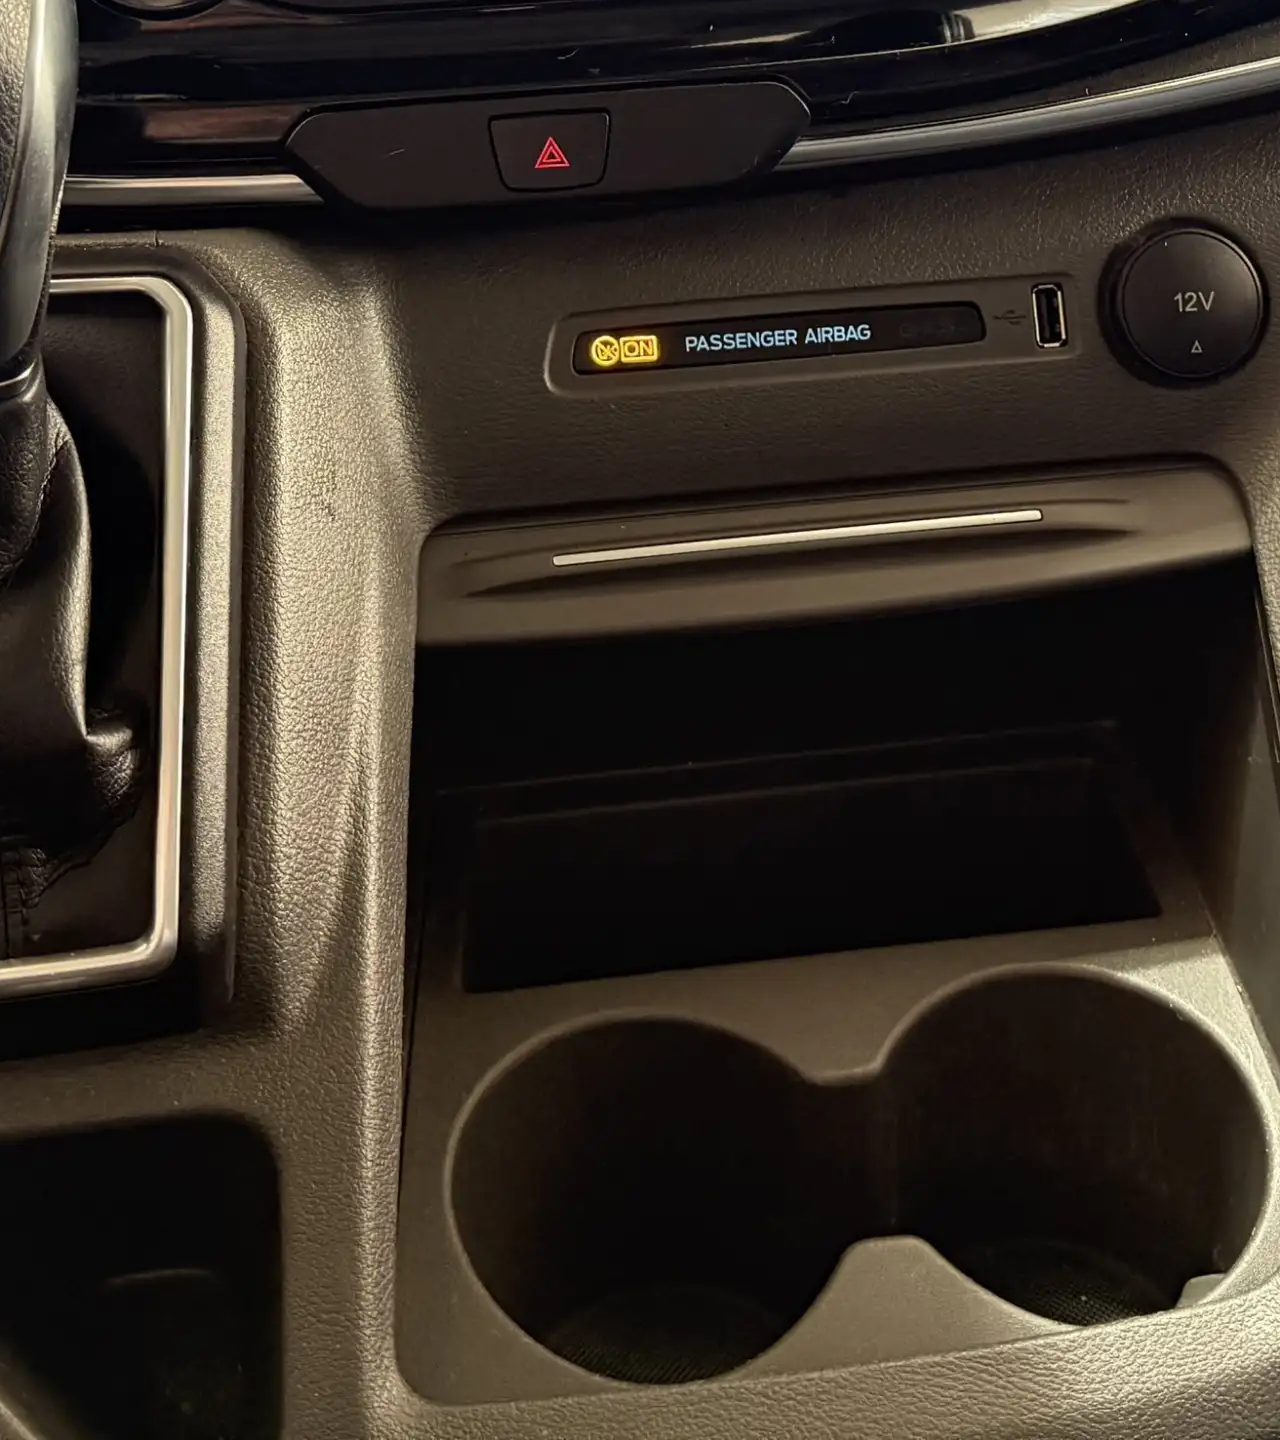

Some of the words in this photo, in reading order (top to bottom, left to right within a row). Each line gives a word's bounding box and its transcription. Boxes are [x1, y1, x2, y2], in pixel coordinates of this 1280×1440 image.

[1173, 290, 1216, 313] 12V
[623, 339, 655, 358] ON
[684, 328, 798, 353] PASSENGER
[804, 323, 872, 344] AIRBAG
